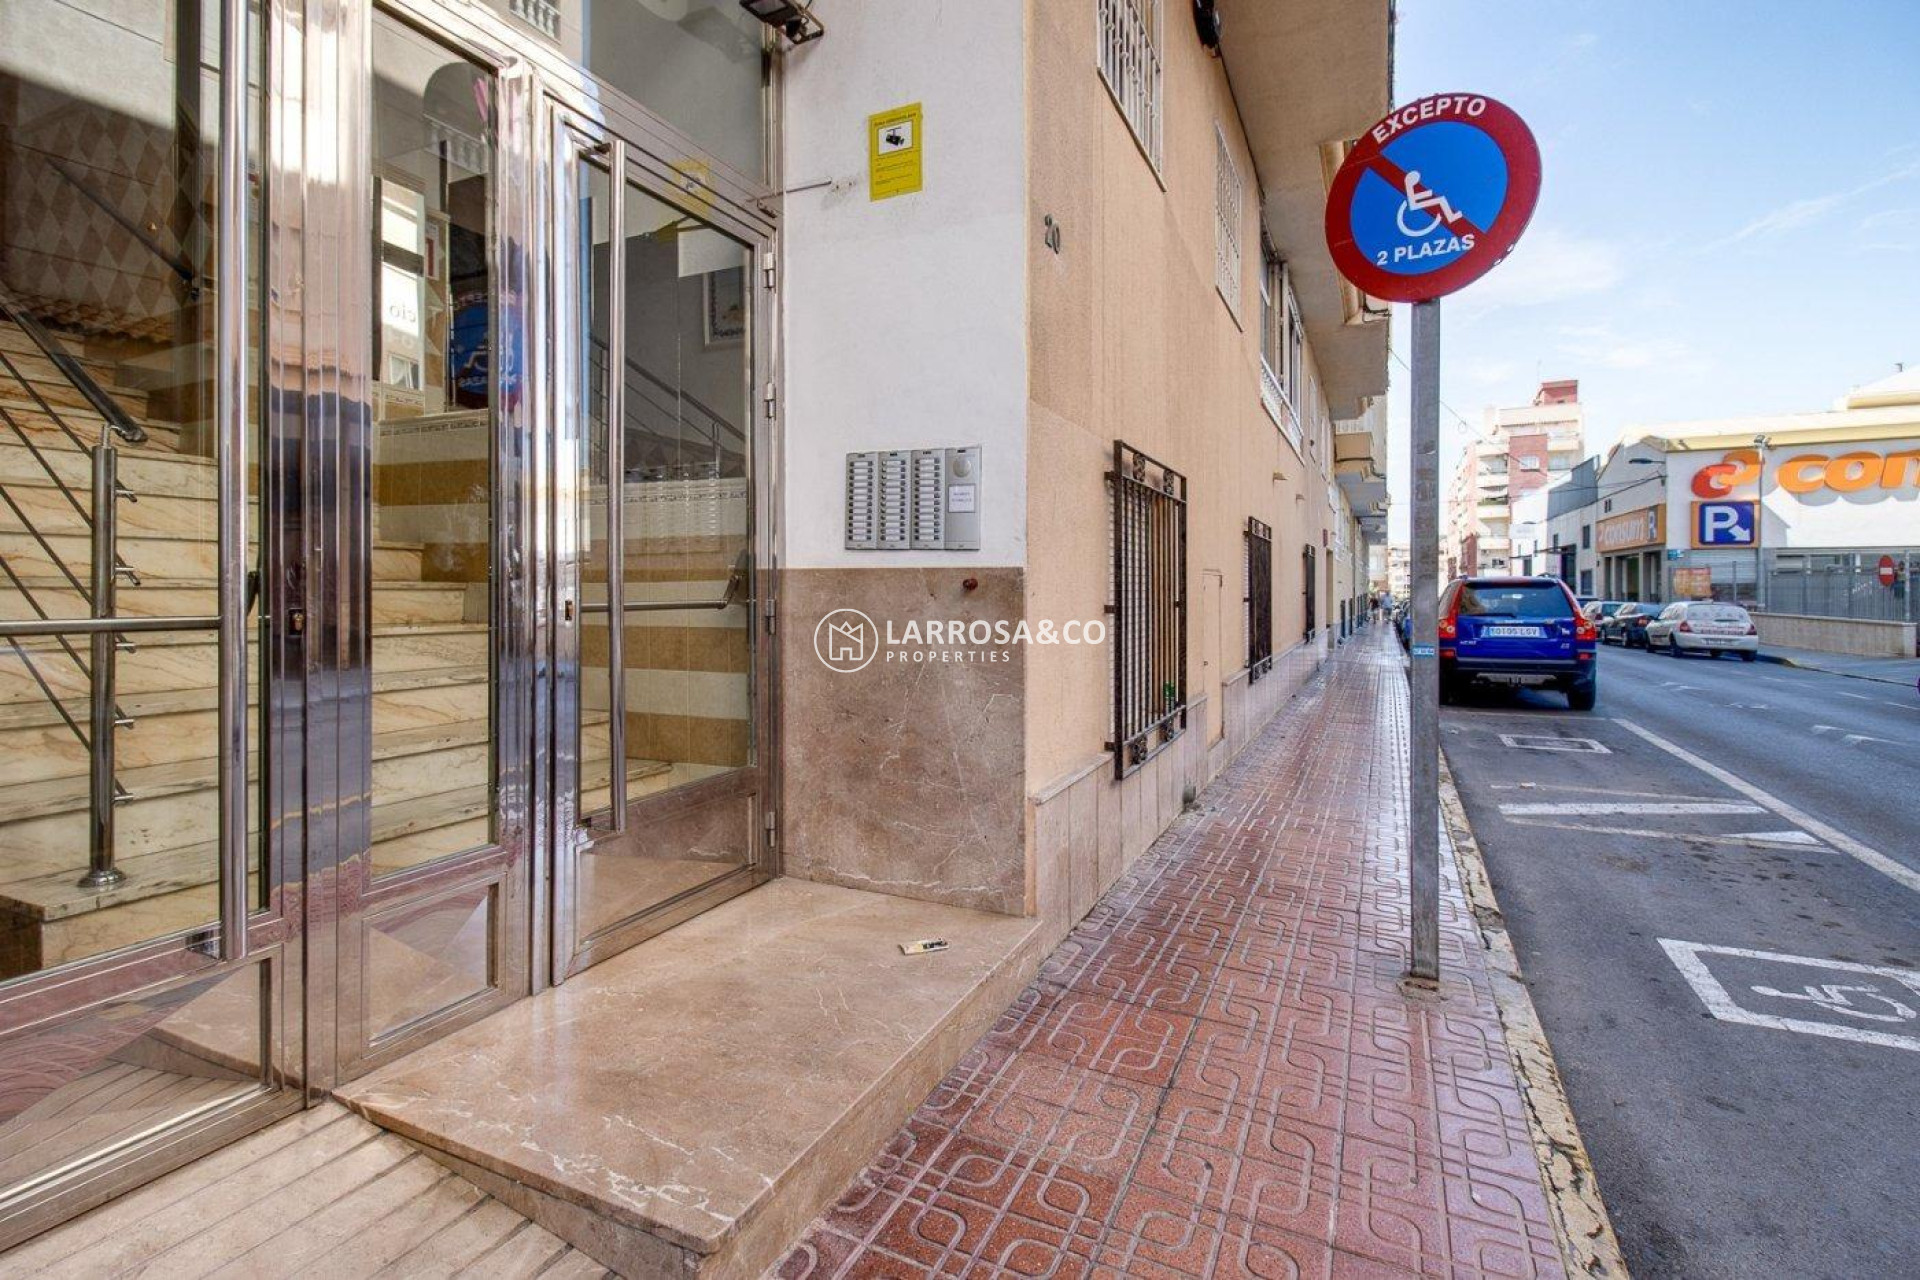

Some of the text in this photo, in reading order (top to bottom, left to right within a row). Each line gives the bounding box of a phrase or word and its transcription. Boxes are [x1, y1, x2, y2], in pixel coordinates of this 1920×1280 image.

[1372, 96, 1486, 144] EXCEPTO
[1044, 214, 1061, 254] 20
[1377, 234, 1475, 266] 2 PLAZAS
[1704, 505, 1739, 542] P
